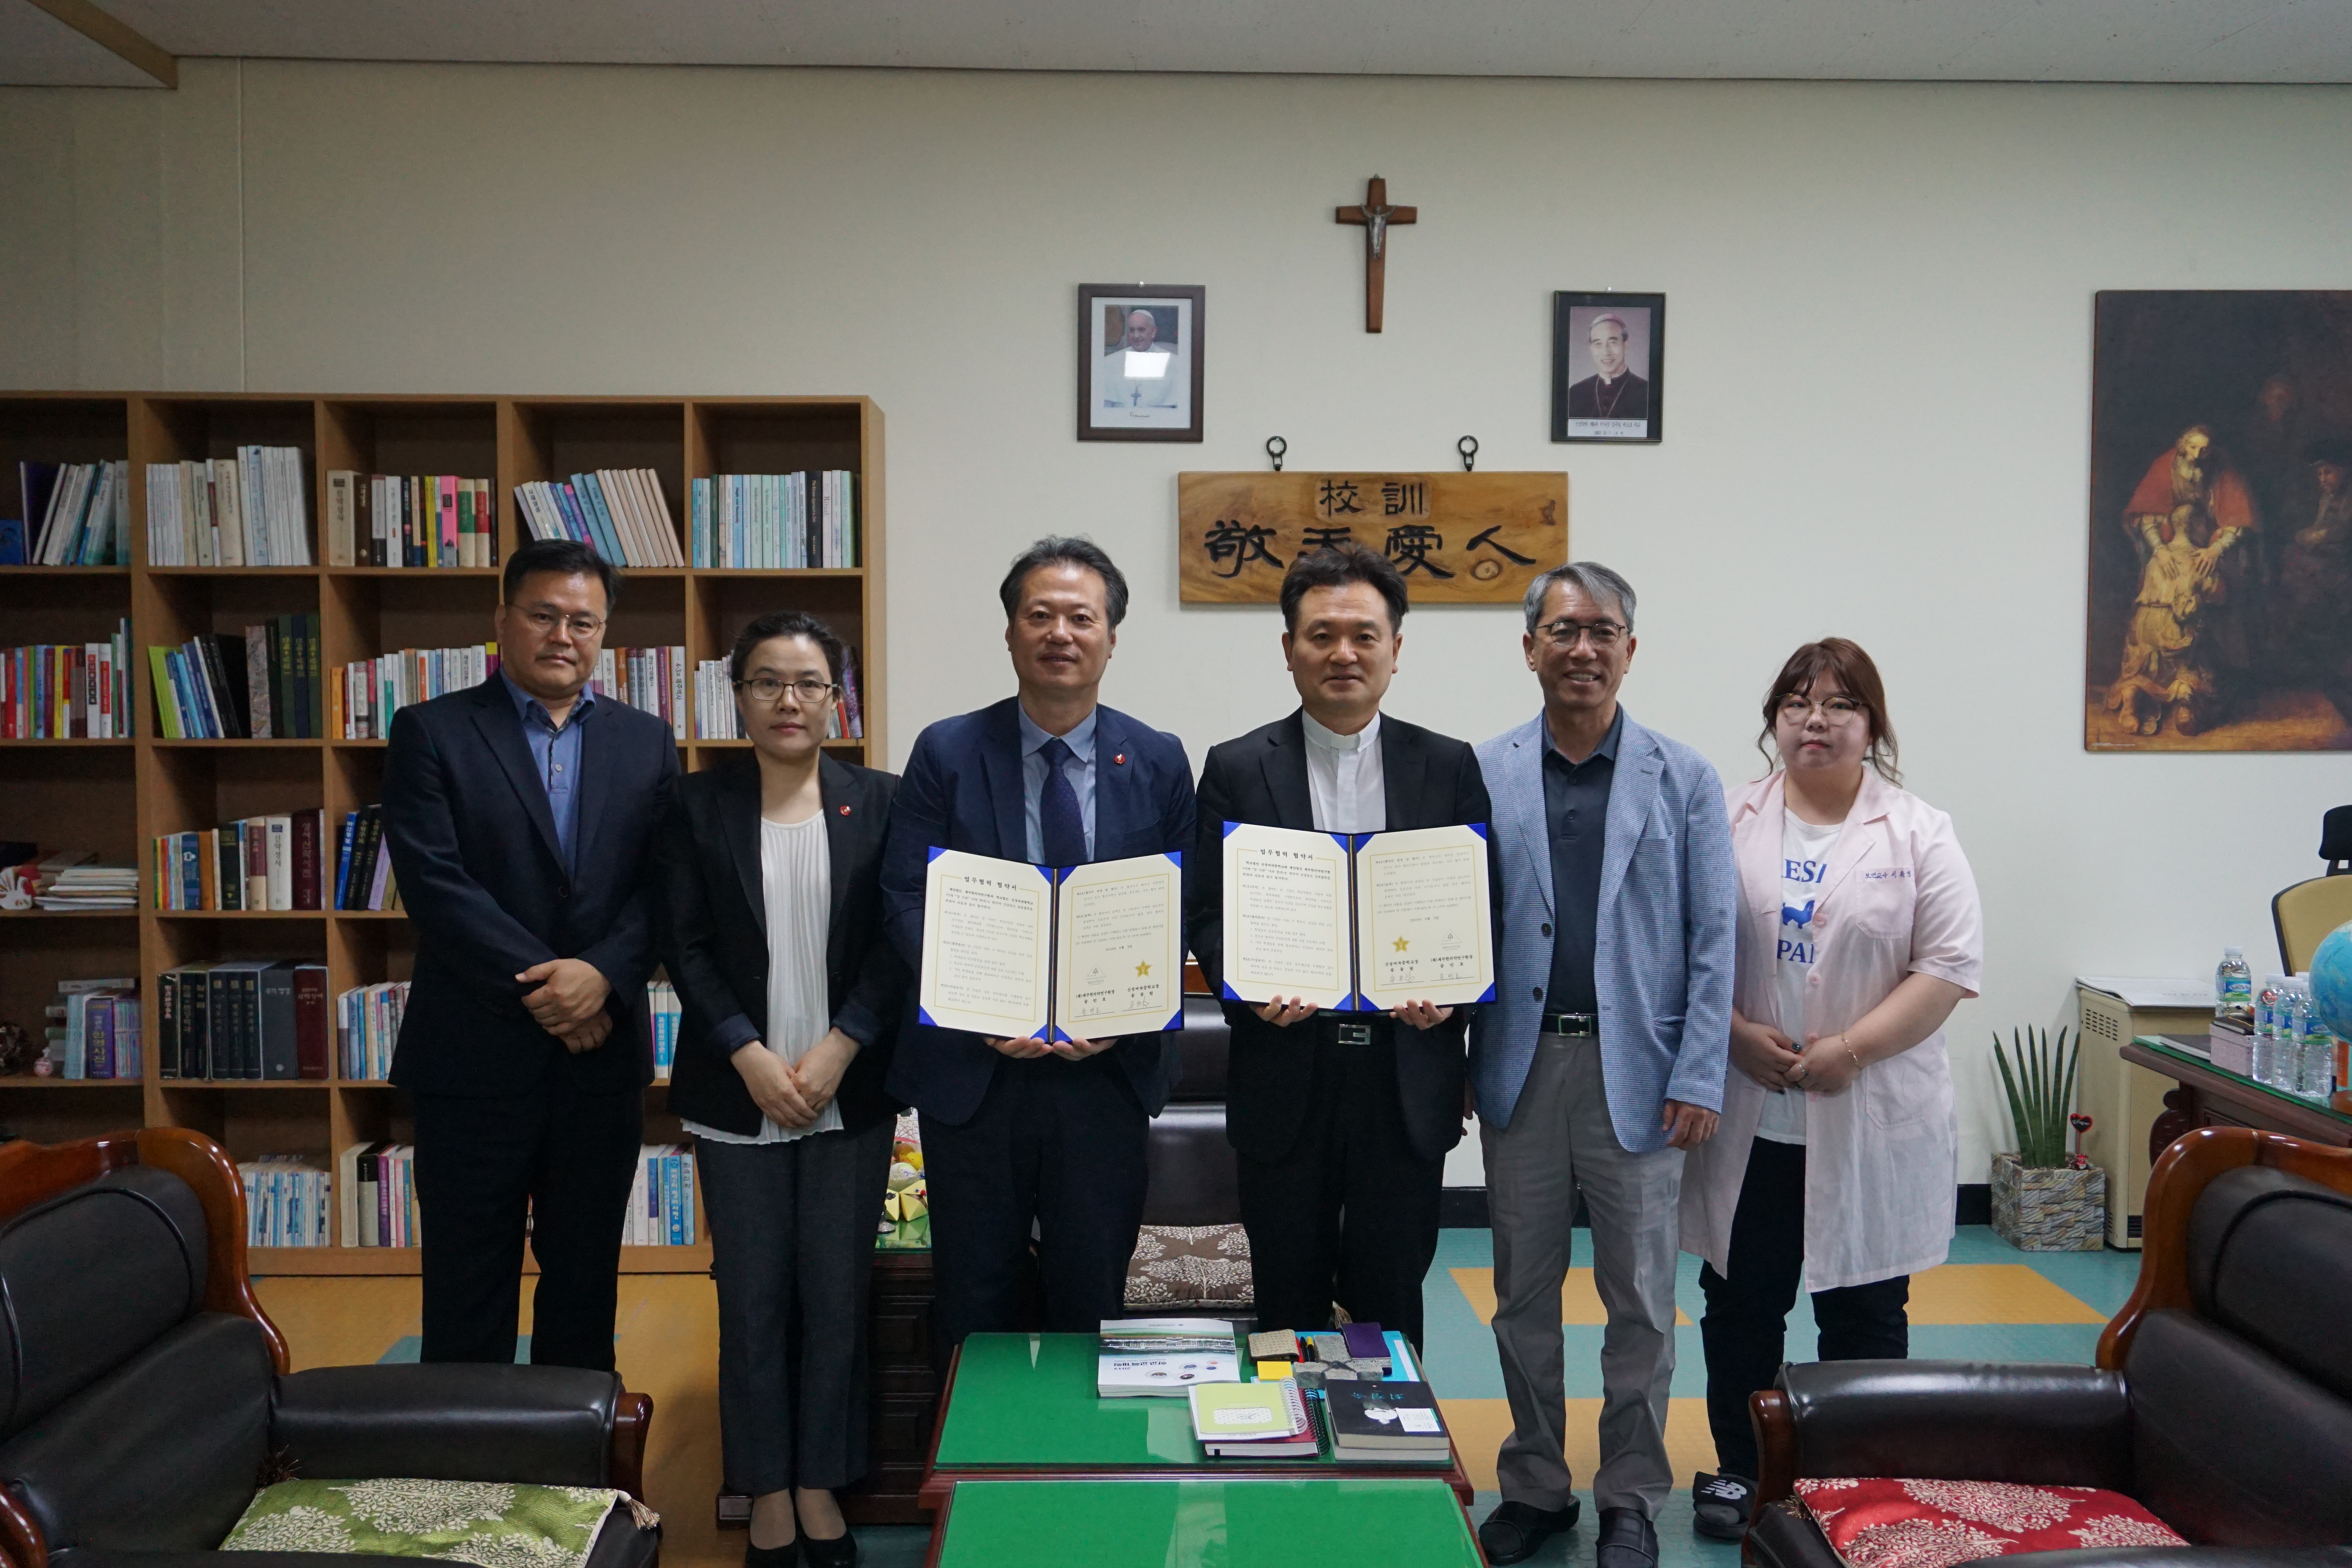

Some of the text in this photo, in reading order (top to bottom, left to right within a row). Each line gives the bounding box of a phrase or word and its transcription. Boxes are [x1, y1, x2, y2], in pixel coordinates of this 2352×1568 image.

[1319, 479, 1425, 517] 校訓
[1260, 848, 1312, 860] 업무협력 협약서
[964, 875, 1016, 891] 업무협력 협약서
